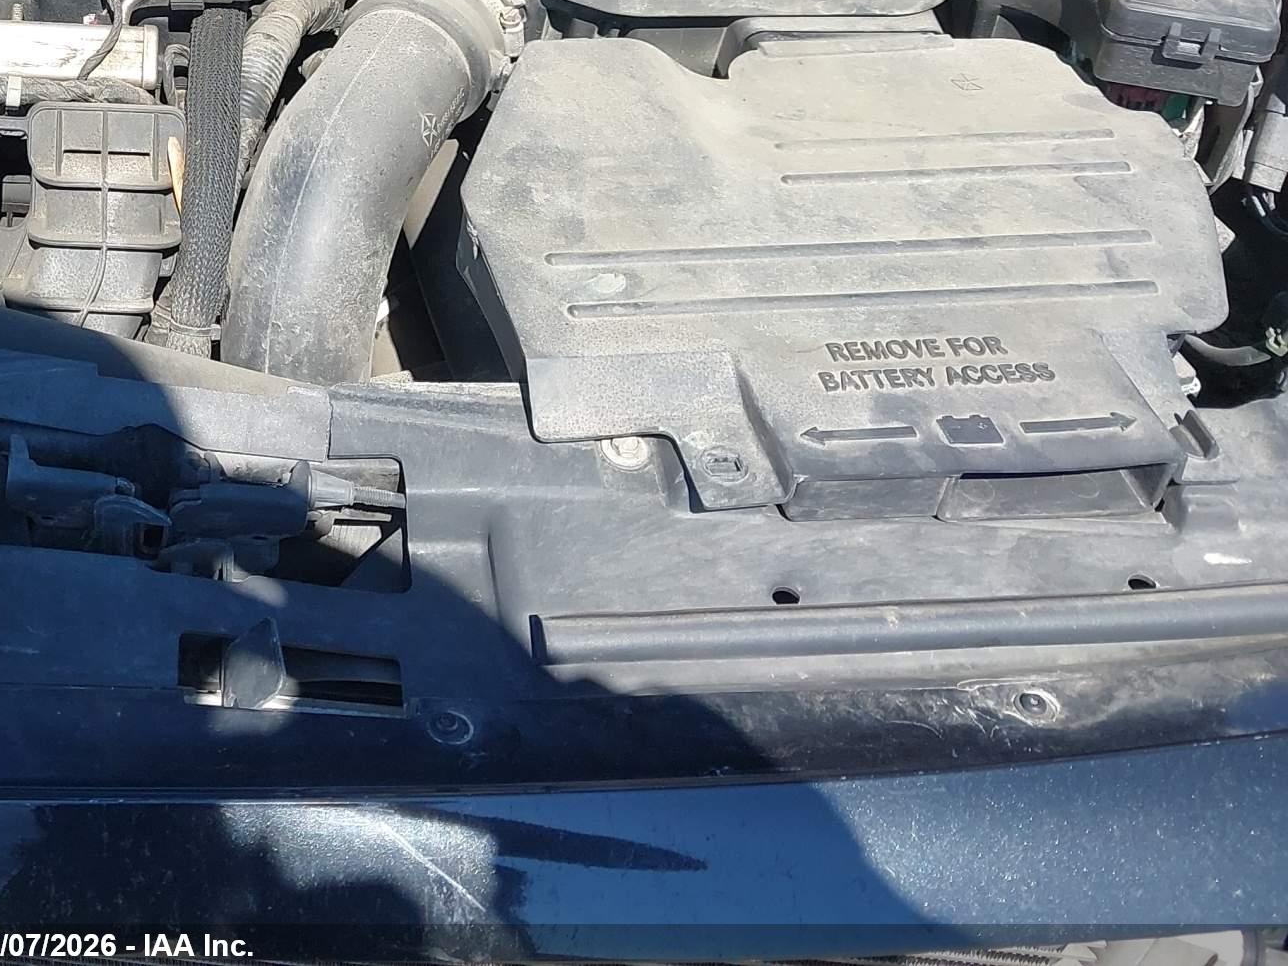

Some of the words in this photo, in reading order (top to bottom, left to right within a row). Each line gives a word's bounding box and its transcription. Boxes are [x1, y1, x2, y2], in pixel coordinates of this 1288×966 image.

[824, 338, 946, 364] REMOVE
[946, 335, 1009, 357] FOR
[817, 367, 936, 393] BATTERY
[945, 362, 1056, 387] ACCESS
